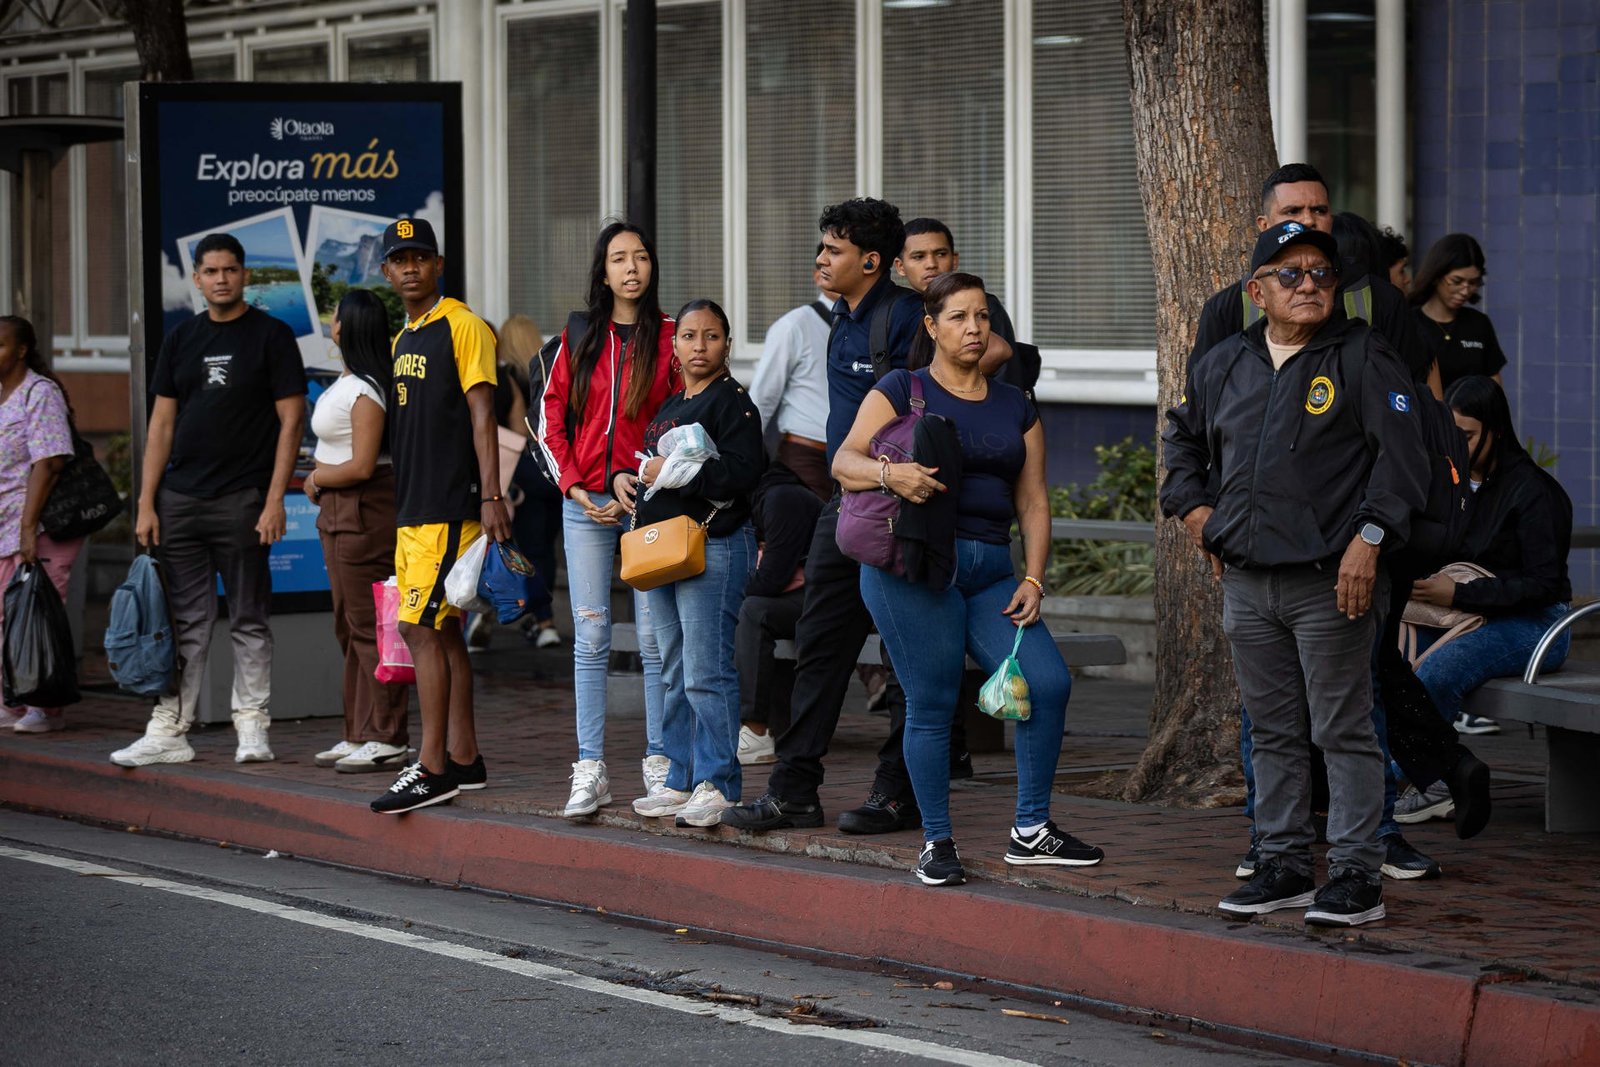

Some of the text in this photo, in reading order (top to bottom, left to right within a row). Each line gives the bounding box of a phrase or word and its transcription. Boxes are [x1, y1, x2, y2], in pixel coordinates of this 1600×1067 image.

[284, 119, 335, 136] Olaola
[197, 138, 399, 187] Explora más
[228, 186, 376, 206] preocúpate menos
